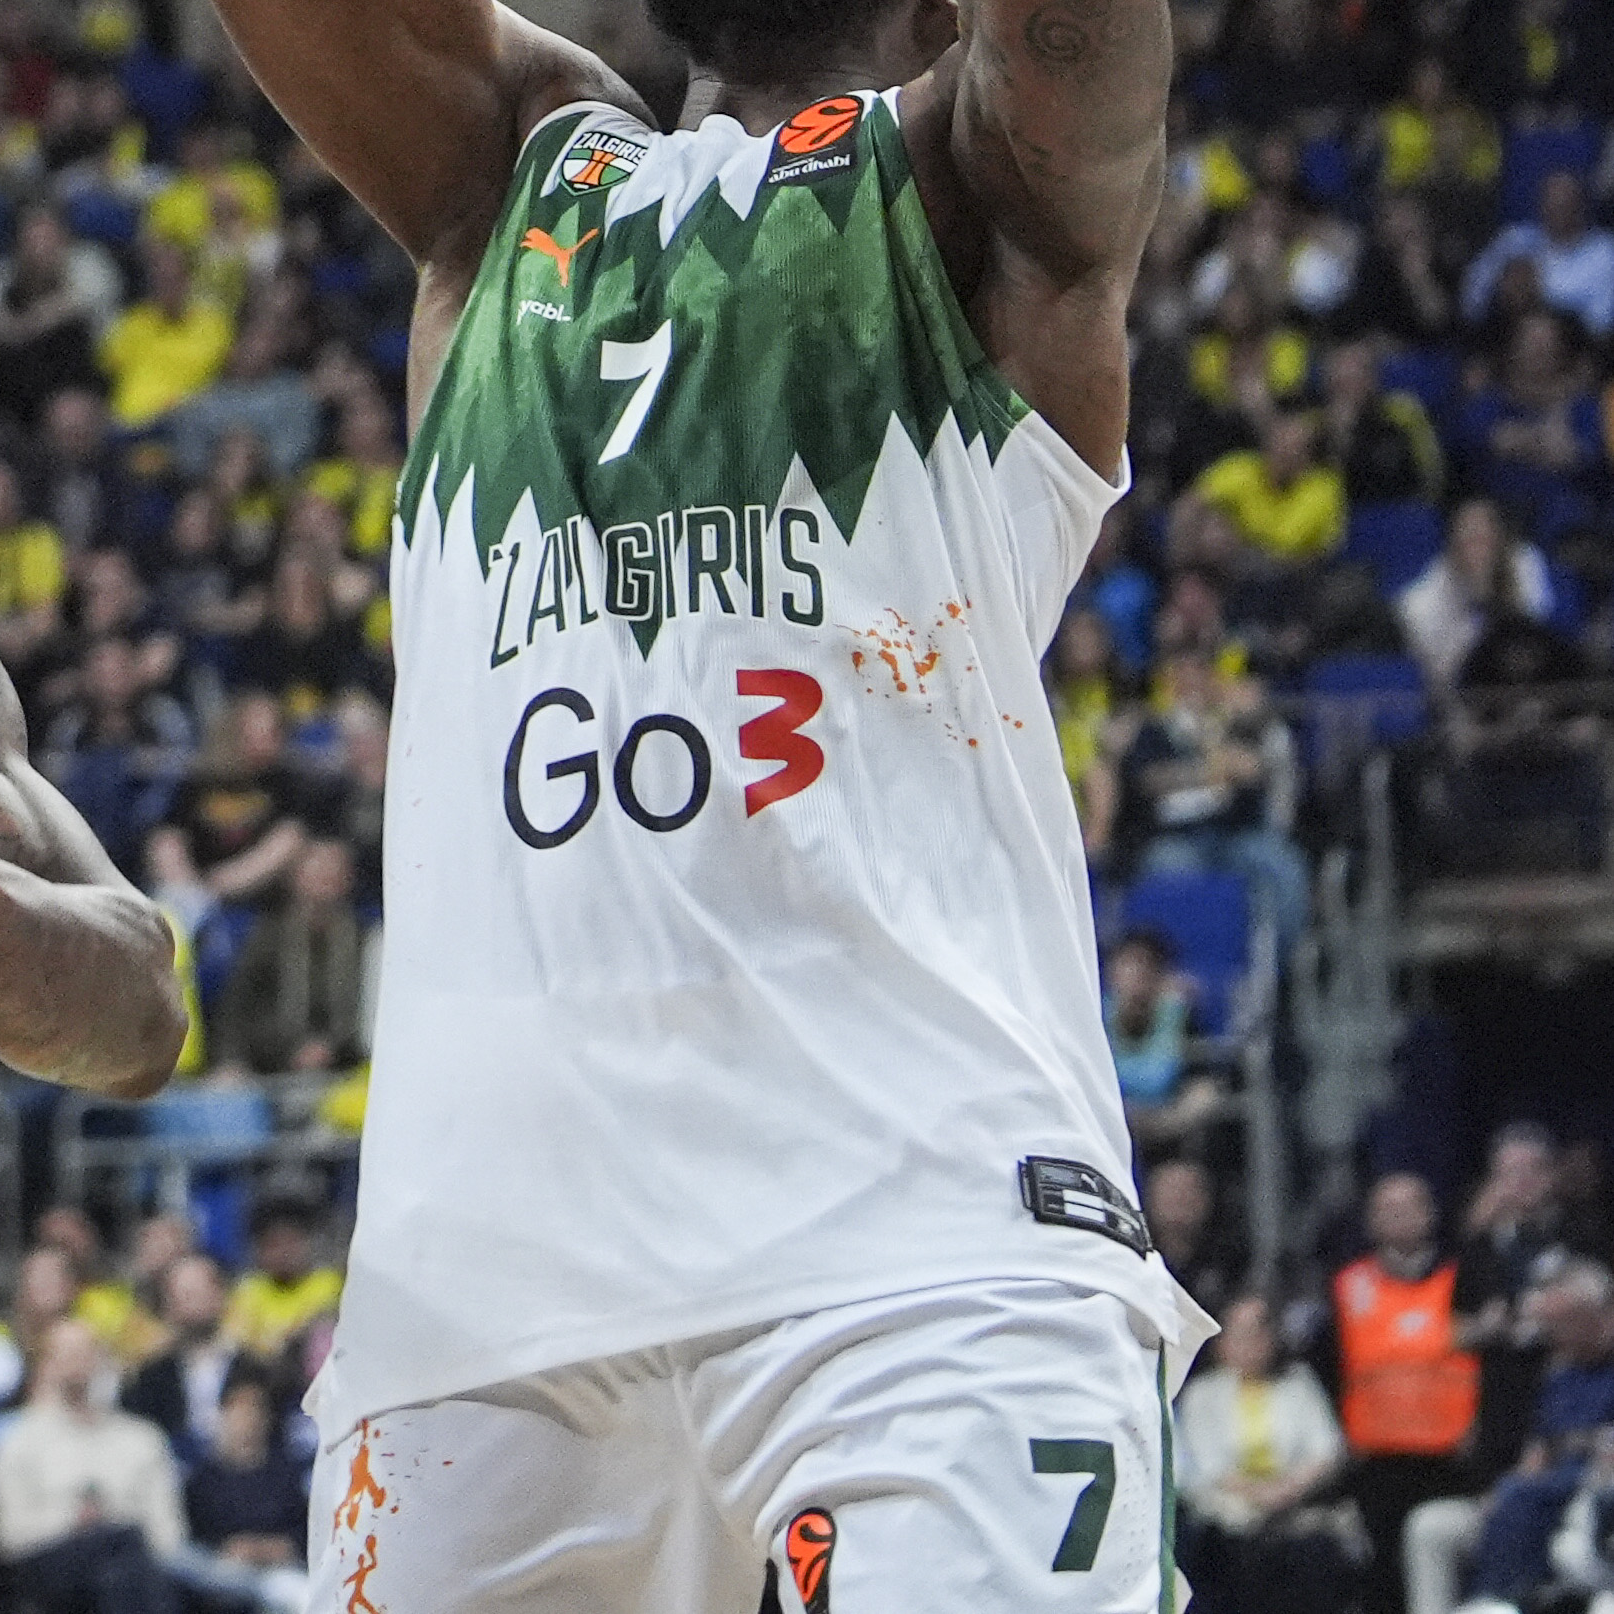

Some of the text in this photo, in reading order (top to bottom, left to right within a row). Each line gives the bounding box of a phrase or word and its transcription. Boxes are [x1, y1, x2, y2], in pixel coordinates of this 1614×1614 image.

[600, 319, 671, 465] 7
[503, 669, 825, 850] Go3
[1029, 1438, 1116, 1572] 7
